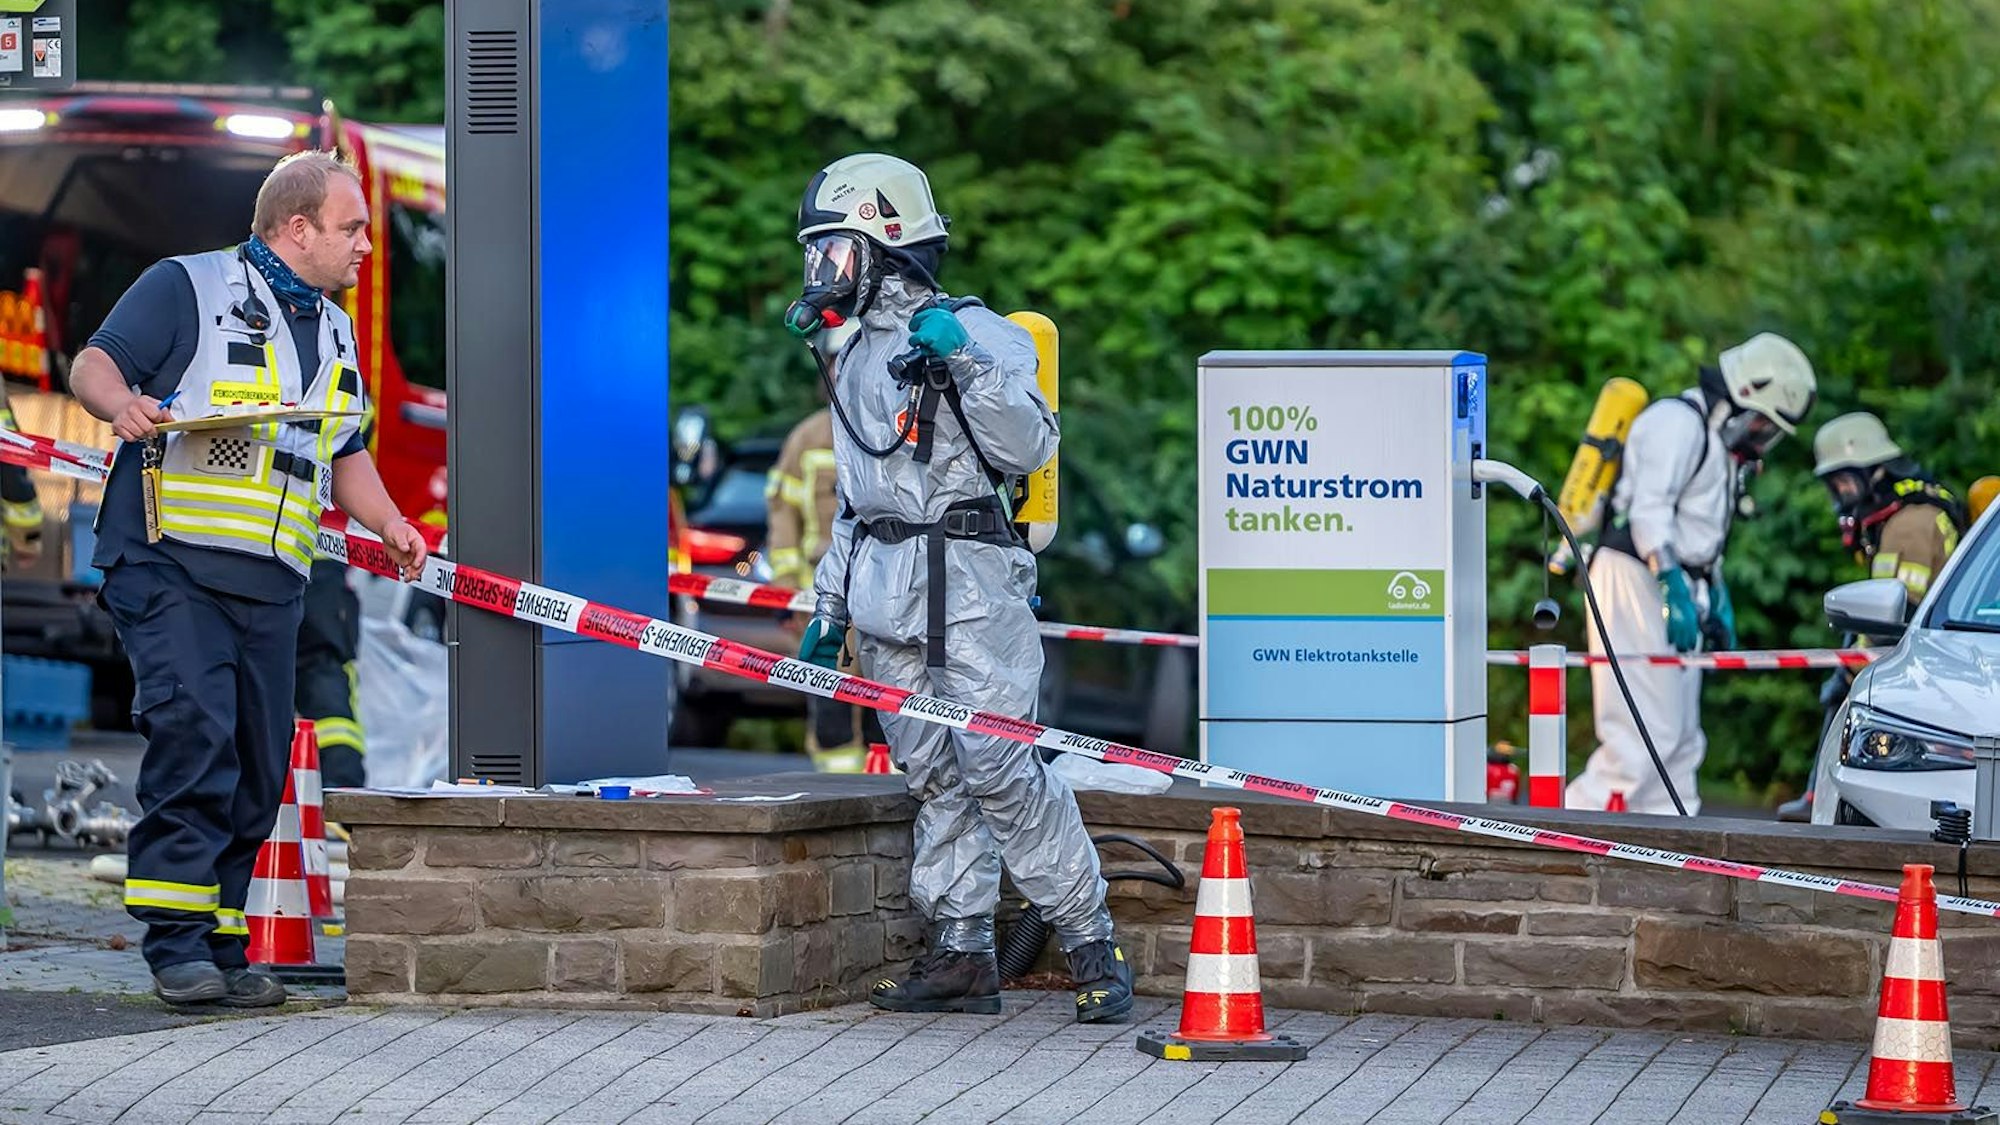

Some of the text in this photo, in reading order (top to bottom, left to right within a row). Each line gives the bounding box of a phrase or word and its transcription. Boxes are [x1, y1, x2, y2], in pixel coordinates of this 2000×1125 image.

[5, 36, 12, 48] 5
[831, 187, 855, 203] WALTER
[1226, 406, 1318, 432] 100%
[1225, 439, 1309, 465] GWN
[1226, 473, 1423, 499] Naturstrom
[1225, 505, 1354, 532] tanken.
[436, 568, 572, 623] FEUERWEHR-SPERRZONE
[584, 609, 729, 662] FEUERWEHR-SPERRZONE
[1252, 648, 1419, 663] GWN Elektrotankstelle
[739, 653, 883, 702] FEUERWEHR-SPERRZONE
